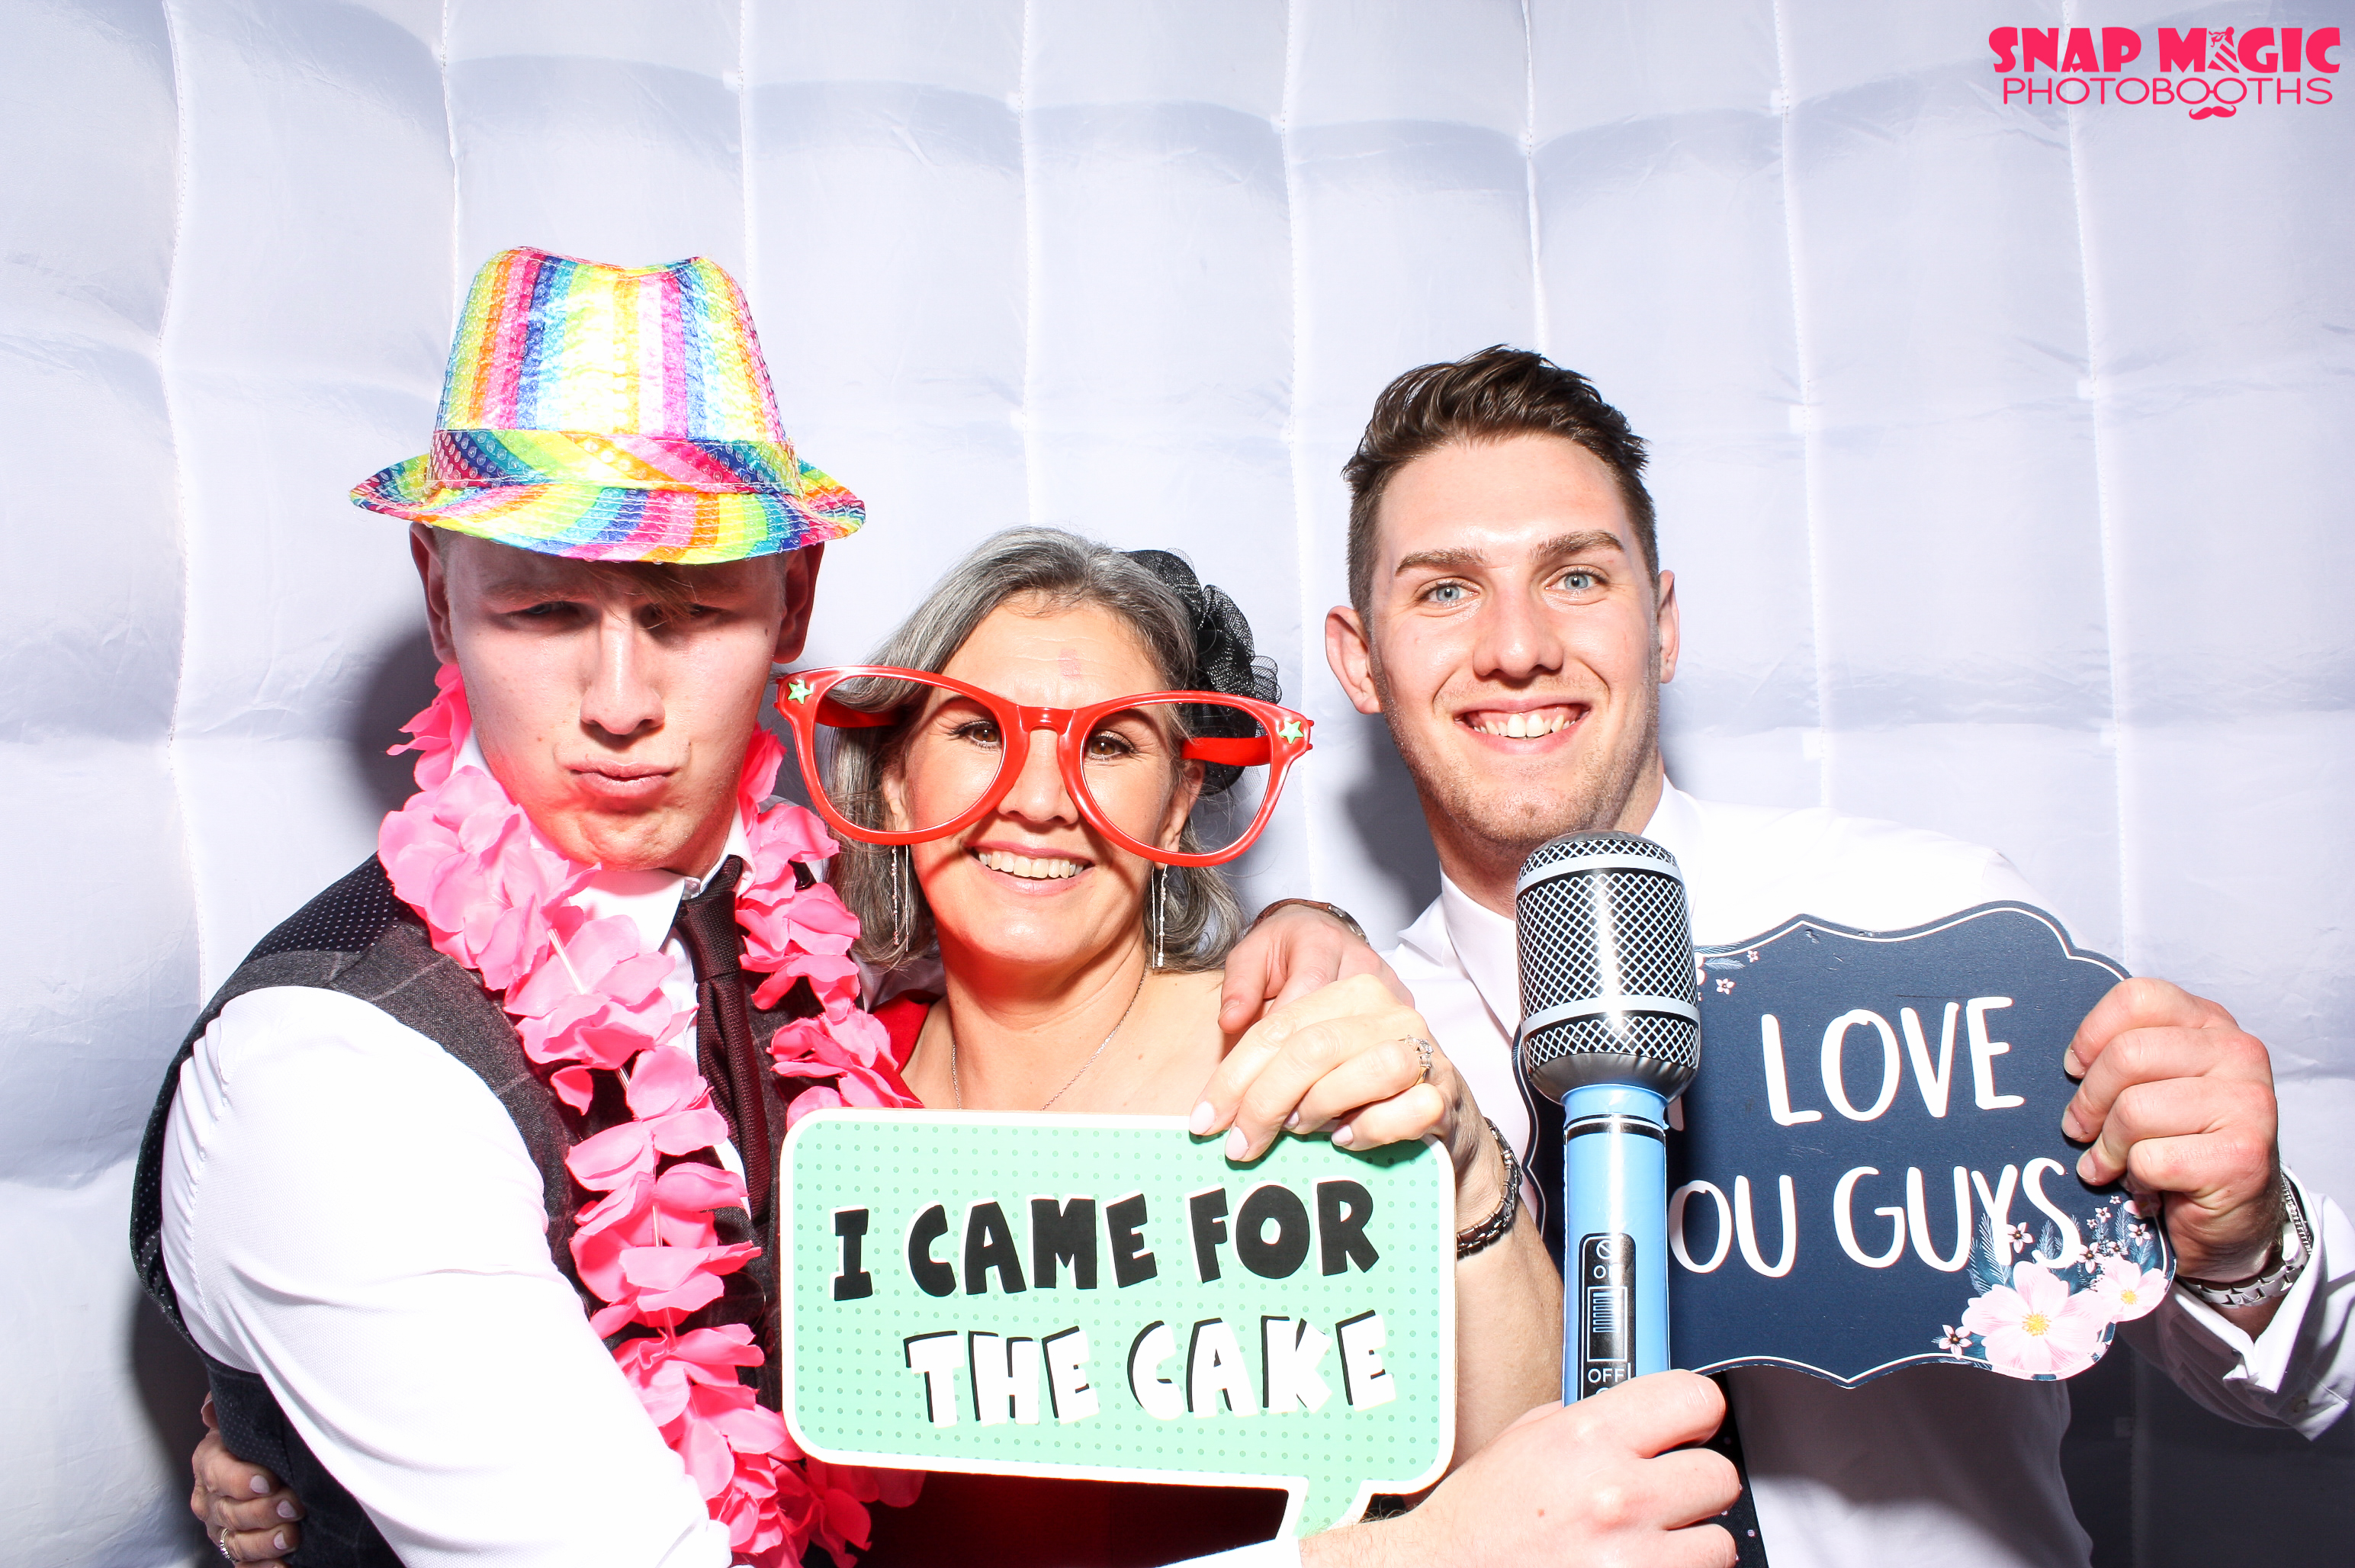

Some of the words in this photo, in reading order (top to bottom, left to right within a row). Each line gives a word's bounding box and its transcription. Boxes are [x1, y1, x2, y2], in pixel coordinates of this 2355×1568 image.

[1760, 996, 2025, 1126] LOVE
[830, 1205, 874, 1301] I
[904, 1190, 1158, 1298] CAME
[1185, 1176, 1380, 1284] FOR
[1666, 1174, 1798, 1278] OU
[1832, 1156, 2082, 1273] GUYS
[903, 1325, 1100, 1428] THE
[1127, 1309, 1397, 1421] CAKE
[1587, 1367, 1625, 1383] OFF
